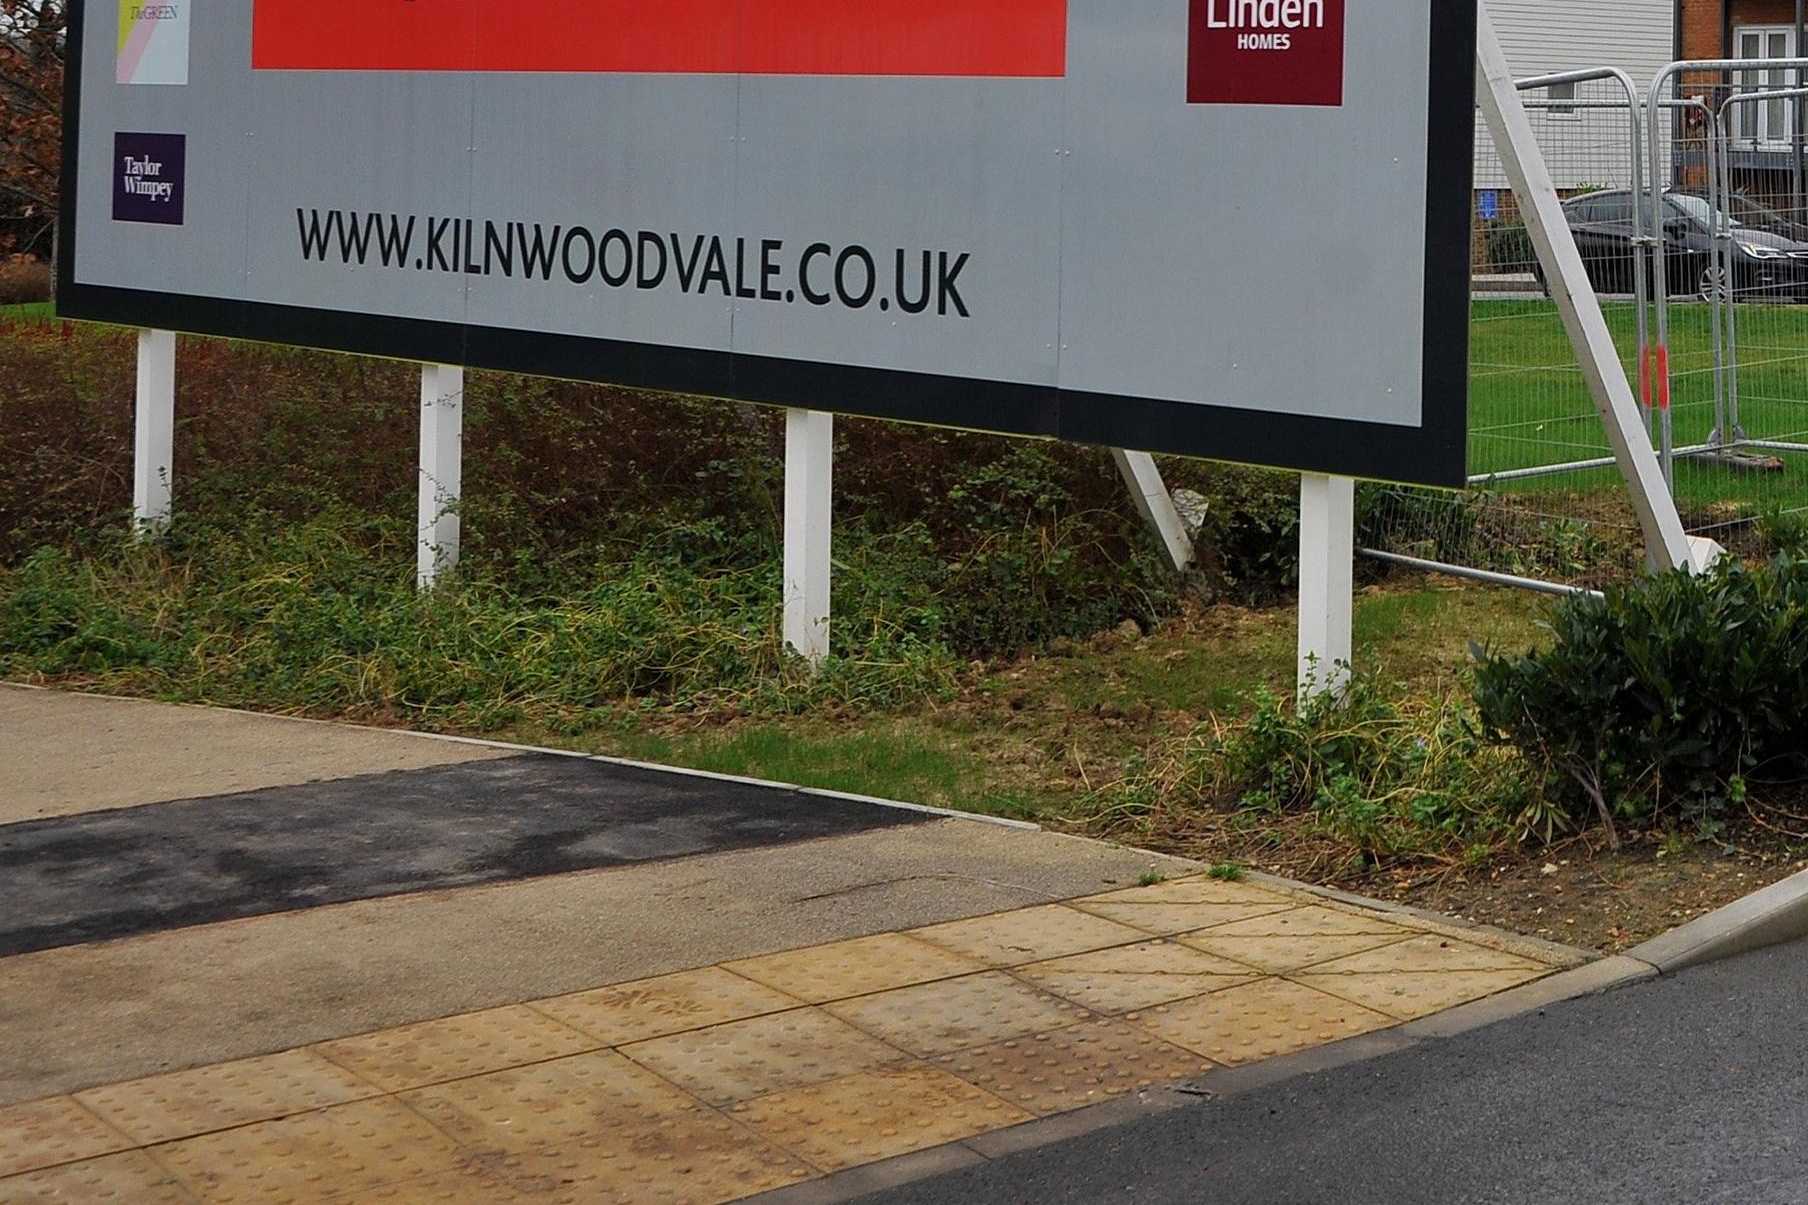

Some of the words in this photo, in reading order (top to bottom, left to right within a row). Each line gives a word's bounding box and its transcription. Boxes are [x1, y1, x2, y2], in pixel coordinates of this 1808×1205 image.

[1237, 33, 1291, 50] HOMES
[124, 155, 162, 180] Taylor
[124, 176, 173, 202] Wimpey
[296, 207, 971, 319] WWW.KILNWOODVALE.CO.UK
